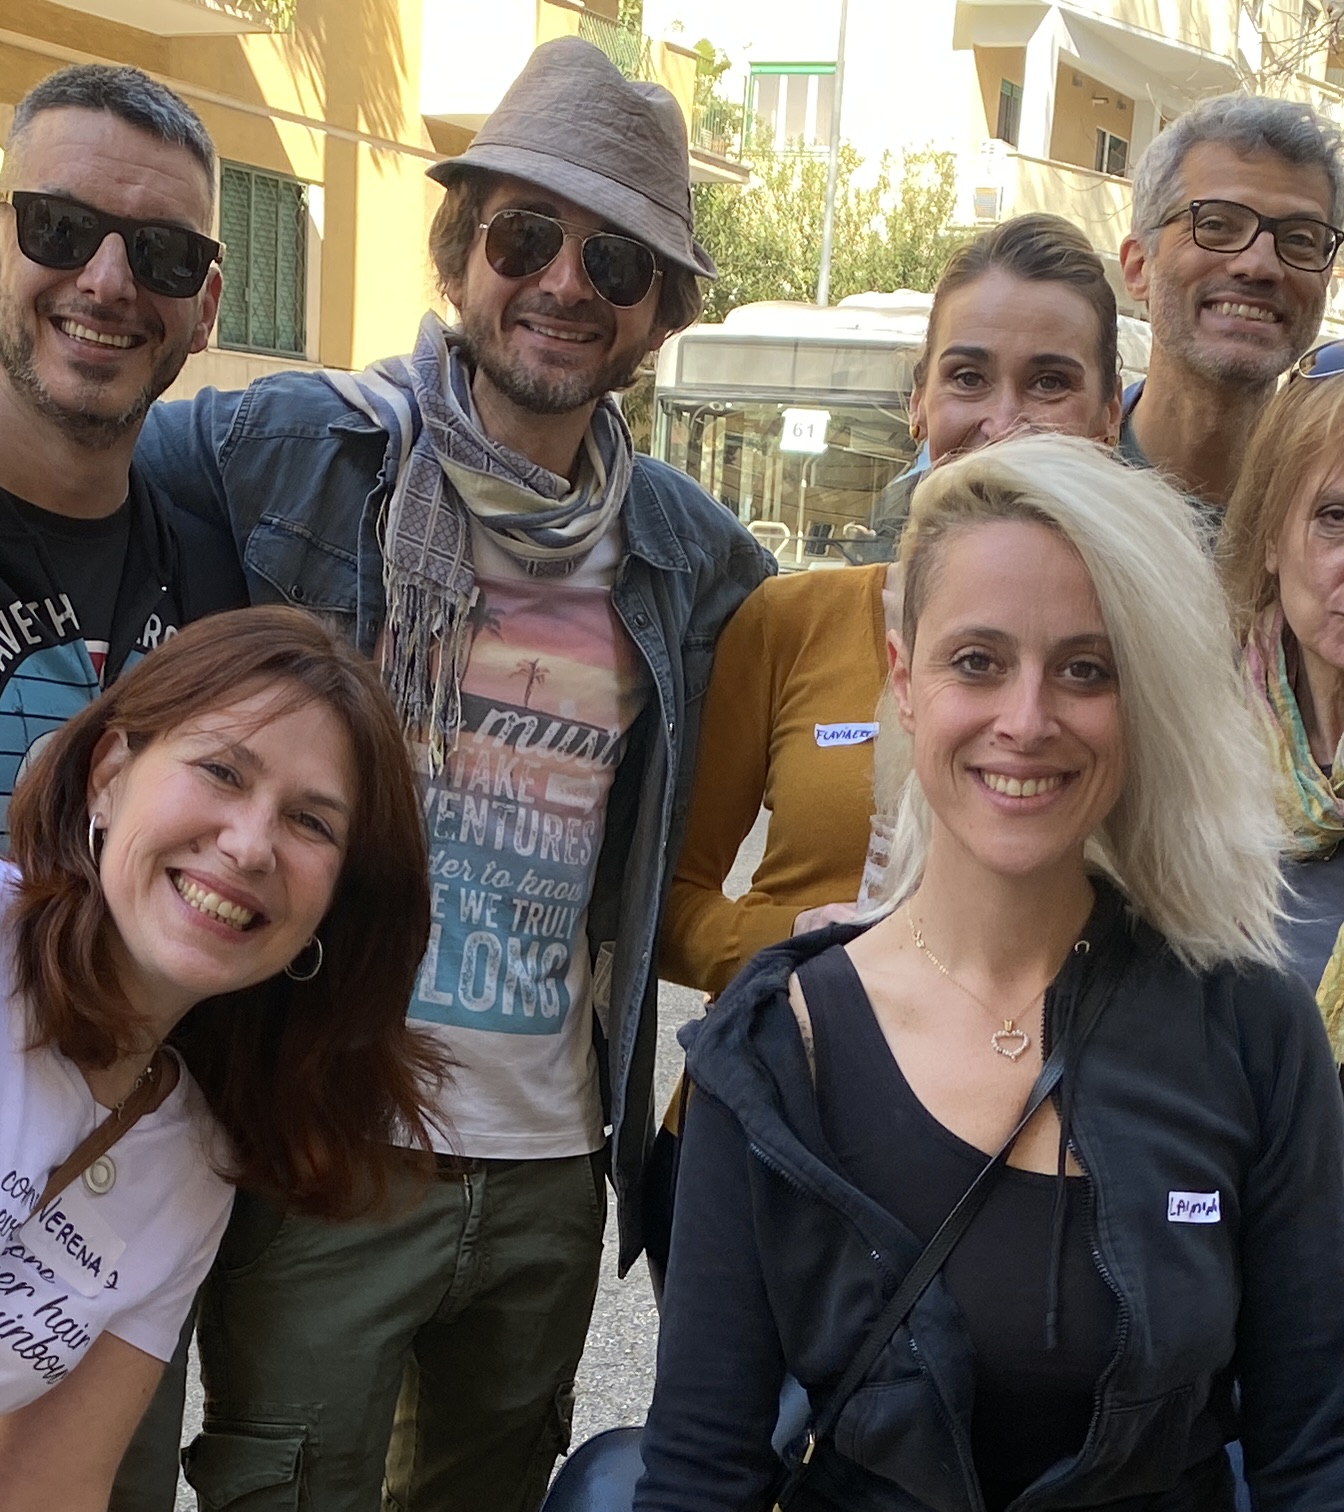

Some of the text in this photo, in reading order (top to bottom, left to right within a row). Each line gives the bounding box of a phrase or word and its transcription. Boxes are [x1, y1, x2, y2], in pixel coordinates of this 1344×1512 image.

[792, 422, 814, 439] 61
[472, 707, 621, 771] must
[447, 746, 542, 804] TAKE
[429, 850, 584, 902] der to know
[460, 887, 503, 929] WE
[511, 898, 581, 940] TRULY
[417, 922, 569, 1019] LONG
[37, 1196, 102, 1278] VERENA
